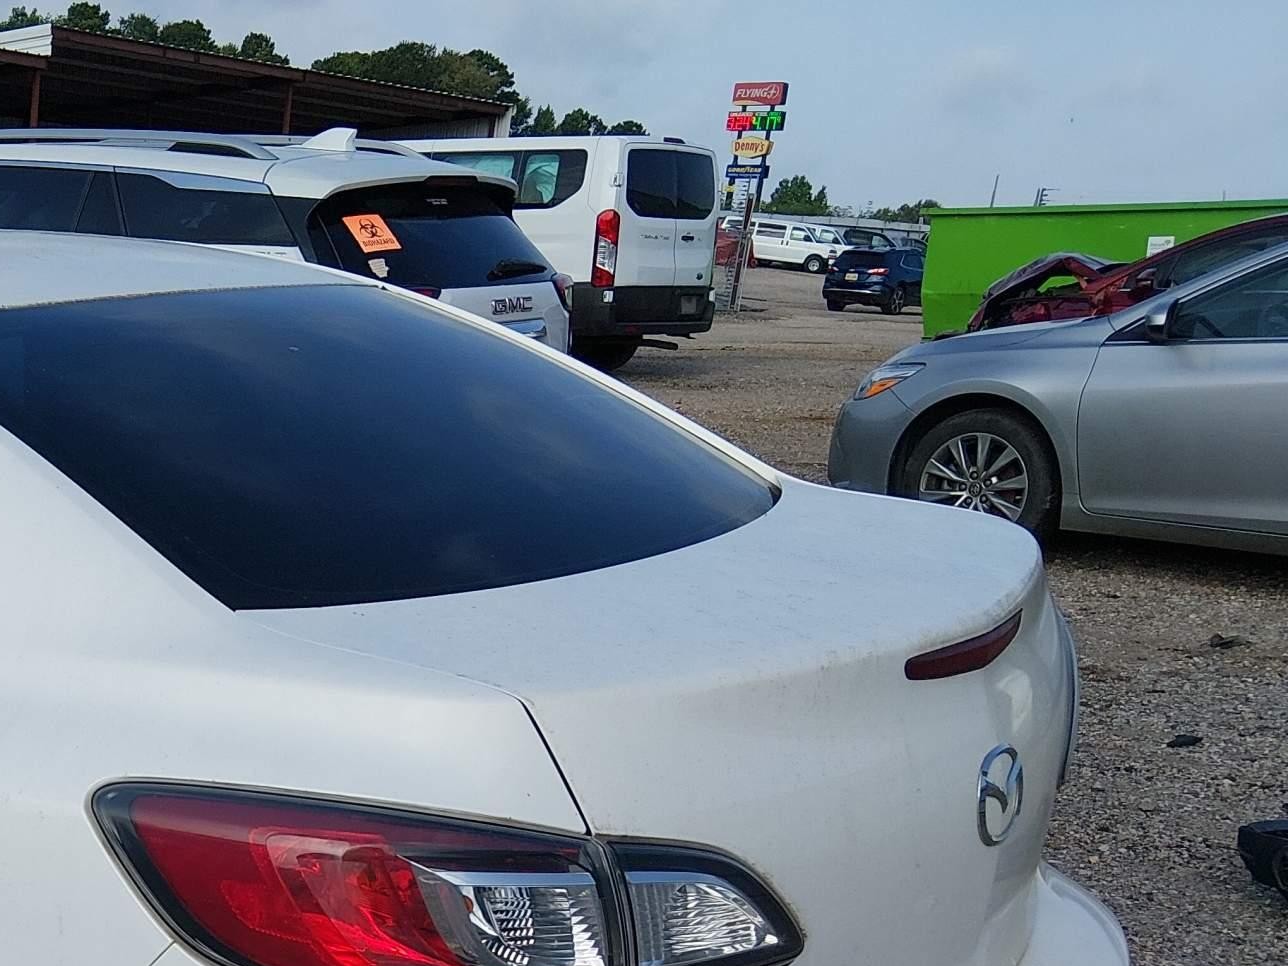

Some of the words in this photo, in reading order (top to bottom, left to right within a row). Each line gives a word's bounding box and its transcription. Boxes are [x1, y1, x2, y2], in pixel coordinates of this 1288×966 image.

[736, 88, 767, 98] FLYING
[734, 141, 765, 153] Denny's
[360, 238, 395, 248] BIOHAZARD
[491, 296, 533, 315] GMC
